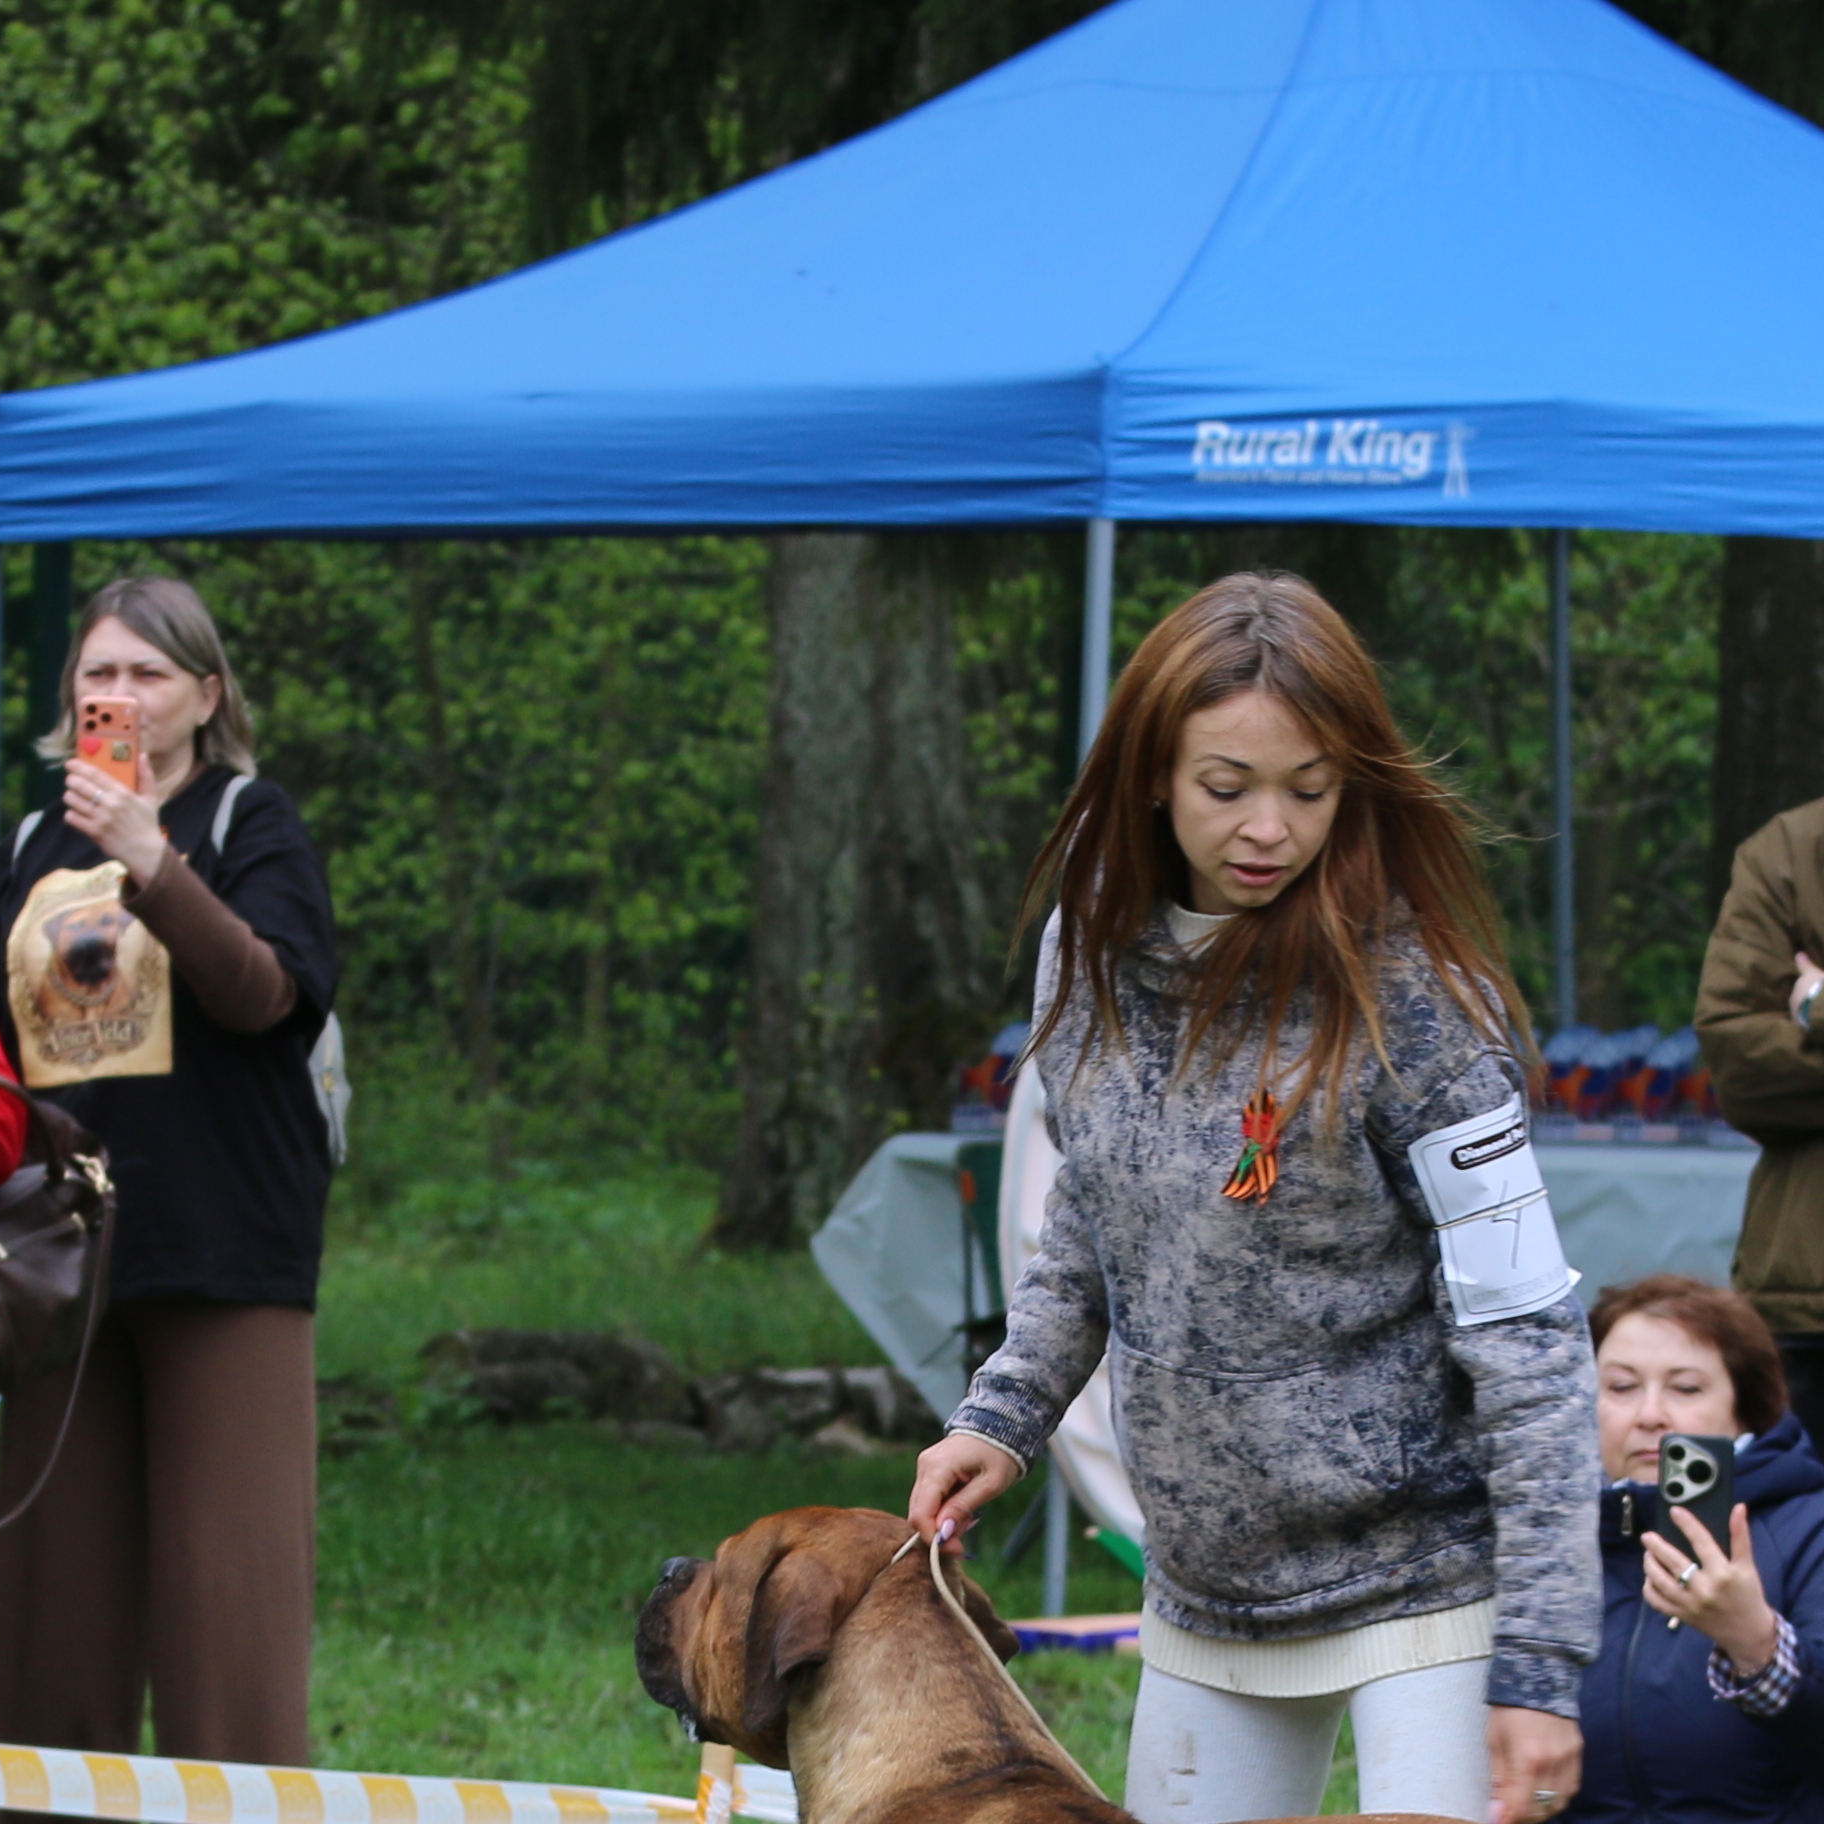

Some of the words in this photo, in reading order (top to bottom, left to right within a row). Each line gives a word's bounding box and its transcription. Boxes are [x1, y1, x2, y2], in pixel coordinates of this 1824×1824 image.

[1191, 419, 1319, 466] Rural
[1326, 419, 1439, 479] King
[1455, 1132, 1512, 1162] Diamond
[1491, 1179, 1523, 1270] 4
